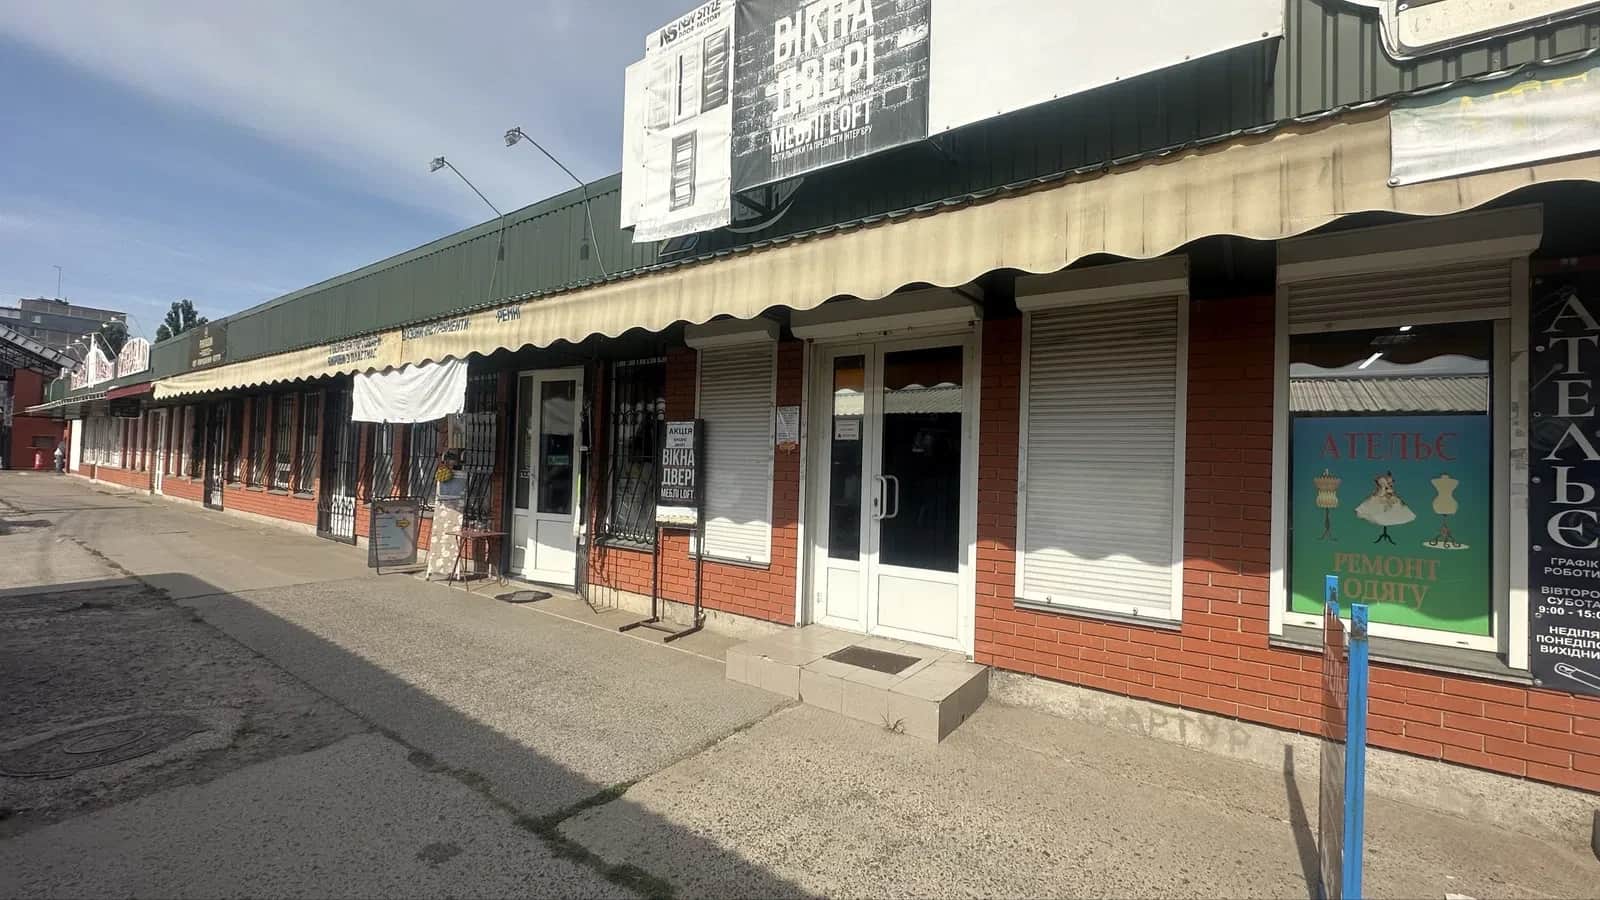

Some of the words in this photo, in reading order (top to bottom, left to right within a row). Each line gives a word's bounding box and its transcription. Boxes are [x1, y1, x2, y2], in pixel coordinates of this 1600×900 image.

[697, 0, 721, 20] STYLE
[696, 12, 721, 28] FACTORY
[774, 0, 874, 64] ВІКНА
[771, 36, 875, 123] ДВЕРІ
[829, 97, 874, 135] LOFT
[1541, 293, 1600, 550] АТЕЛЬЄ
[669, 427, 693, 435] АКЦІЯ
[1321, 432, 1458, 461] АТЕЛЬЄ
[663, 449, 695, 466] ВІКНА
[661, 468, 695, 486] ДВЕРІ
[660, 488, 679, 499] МЕБЛІ
[680, 489, 694, 499] LOFT
[1334, 552, 1440, 581] РЕМОНТ
[1551, 558, 1599, 568] ГРАФІК
[1544, 567, 1600, 579] РОБОТИ
[1344, 578, 1430, 608] ОДЯГУ
[1539, 606, 1565, 616] 9:00
[1549, 626, 1600, 639] НЕДІЛЯ
